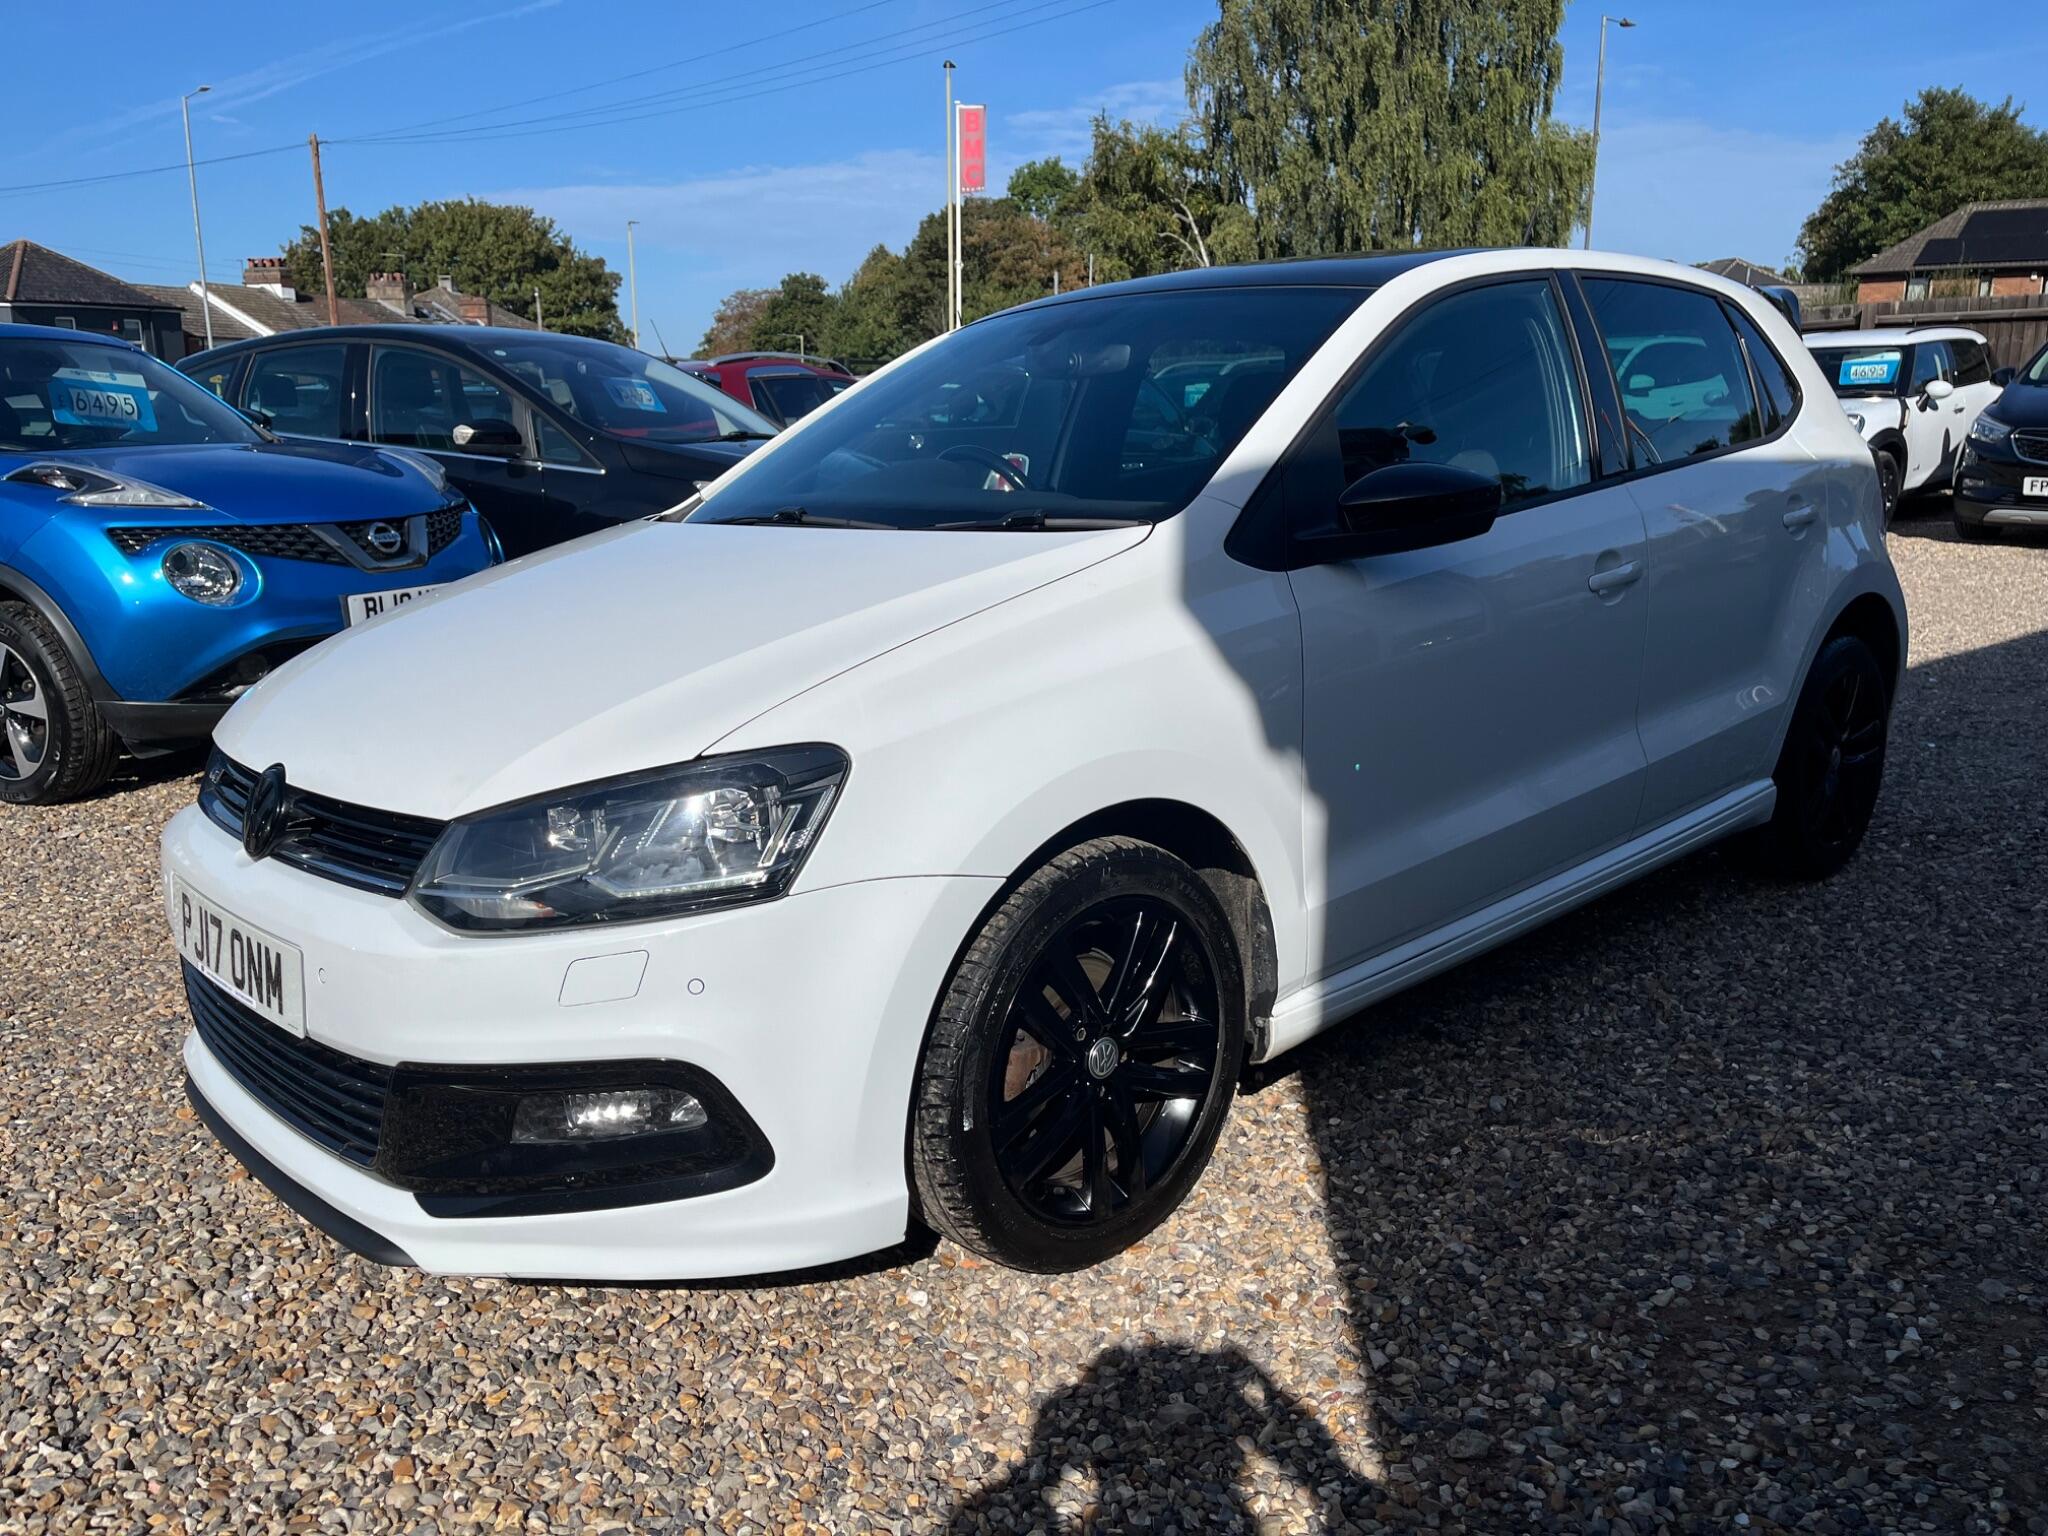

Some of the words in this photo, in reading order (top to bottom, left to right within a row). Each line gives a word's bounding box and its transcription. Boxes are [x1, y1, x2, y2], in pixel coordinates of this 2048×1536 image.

[1851, 366, 1886, 378] 4695
[75, 391, 135, 416] 6495
[182, 892, 223, 974] PJ17
[231, 928, 284, 1016] ONM
